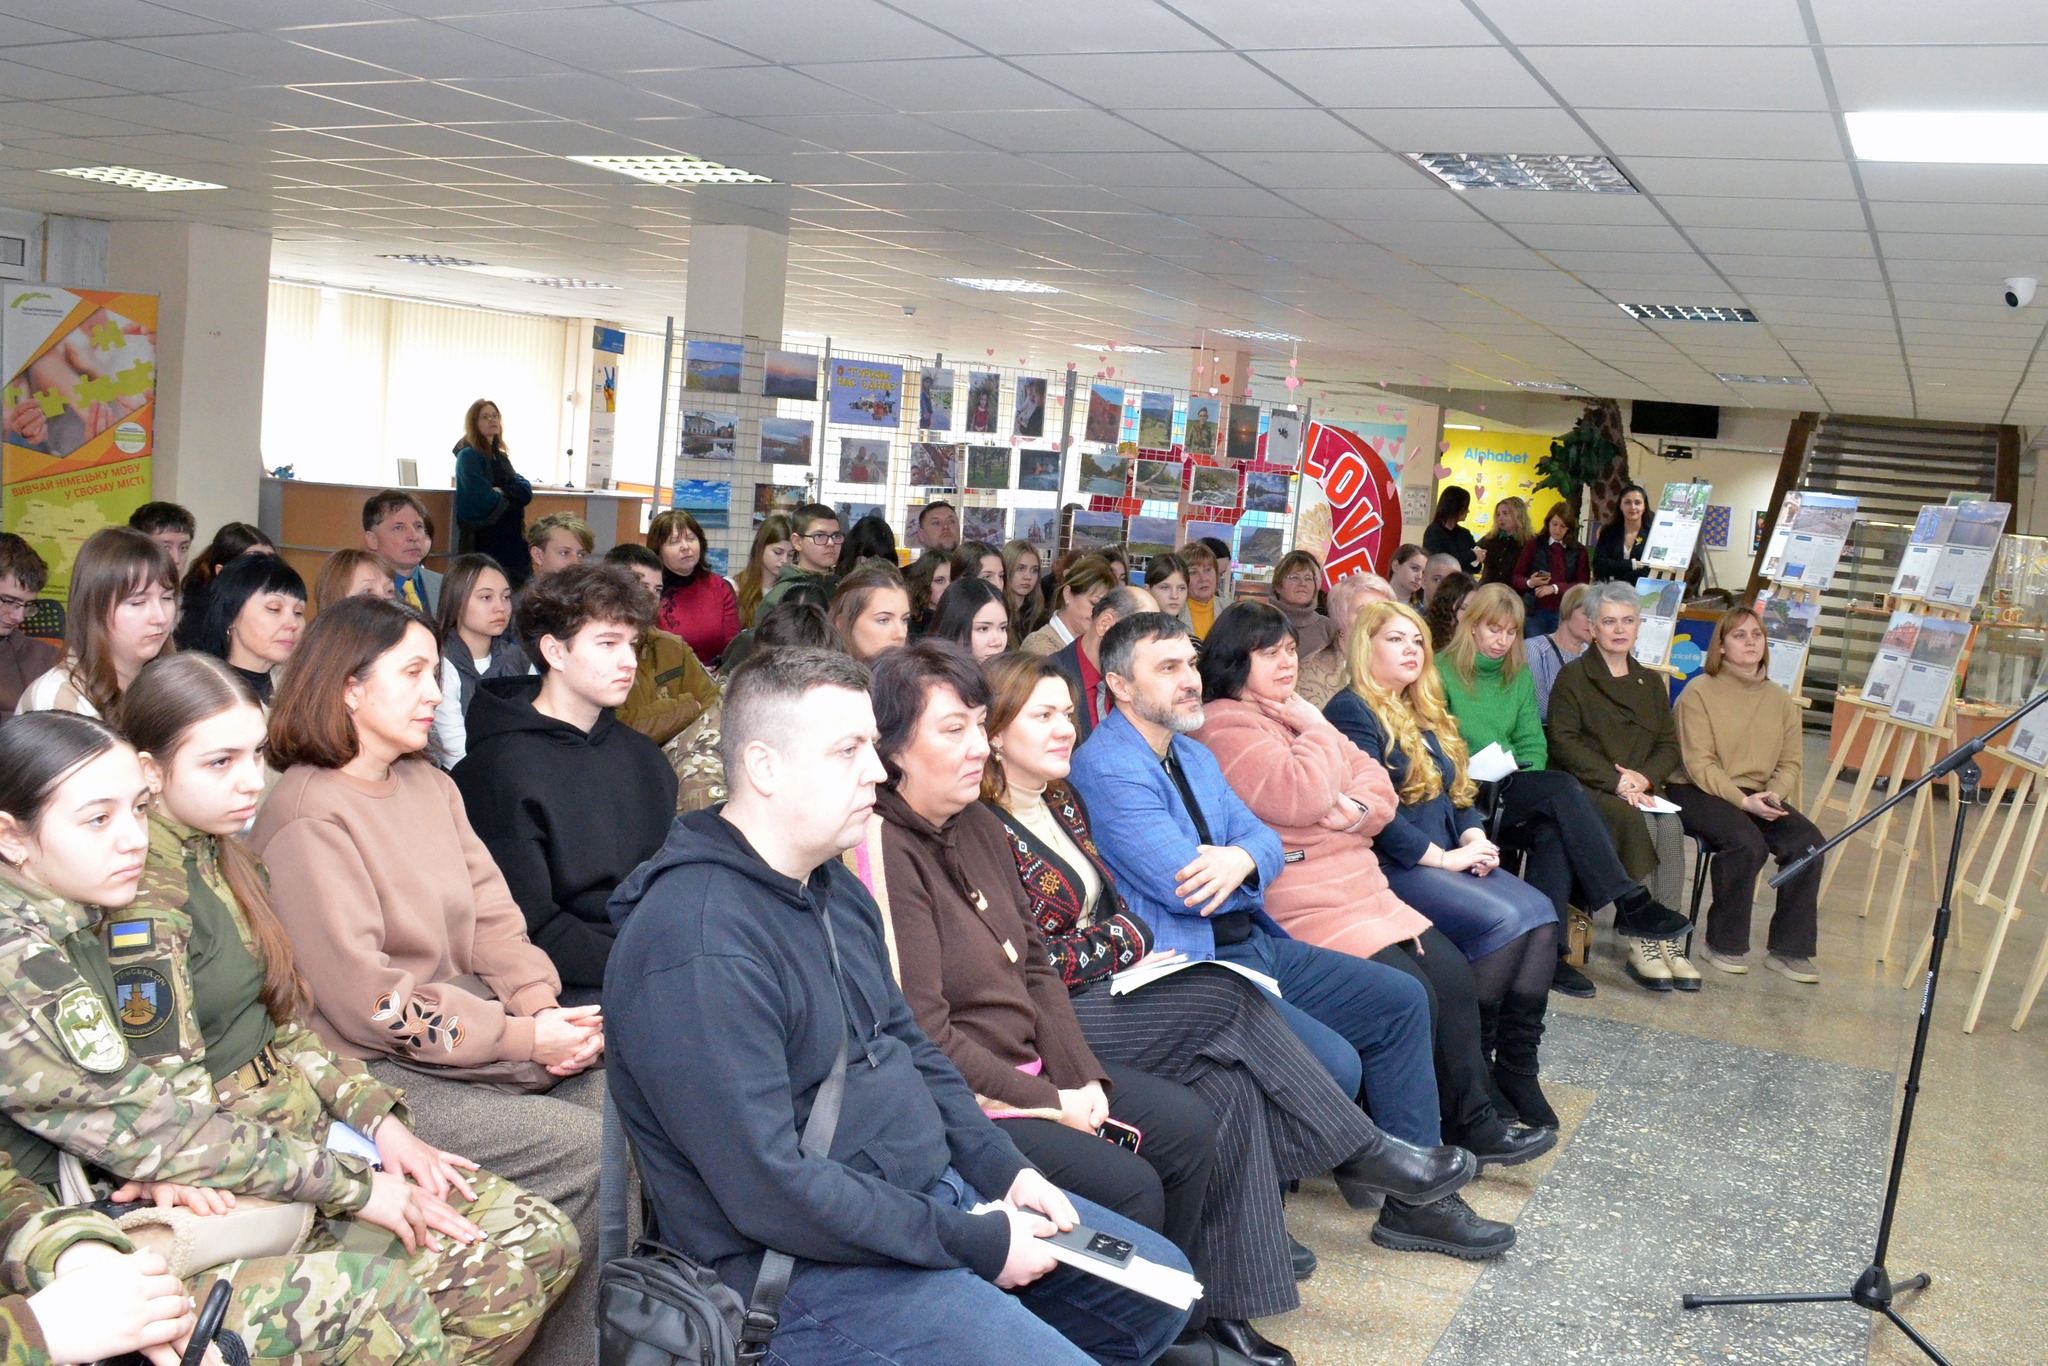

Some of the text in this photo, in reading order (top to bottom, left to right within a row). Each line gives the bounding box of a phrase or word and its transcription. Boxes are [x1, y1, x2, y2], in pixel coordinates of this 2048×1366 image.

[836, 376, 856, 387] НАС
[1464, 447, 1528, 465] Alphabet
[11, 463, 140, 497] ВИВЧАЙ НІМЕЦЬКУ МОВУ
[74, 482, 114, 498] СВОЄМУ
[117, 476, 145, 489] МІСТІ
[1294, 420, 1384, 590] LOVE
